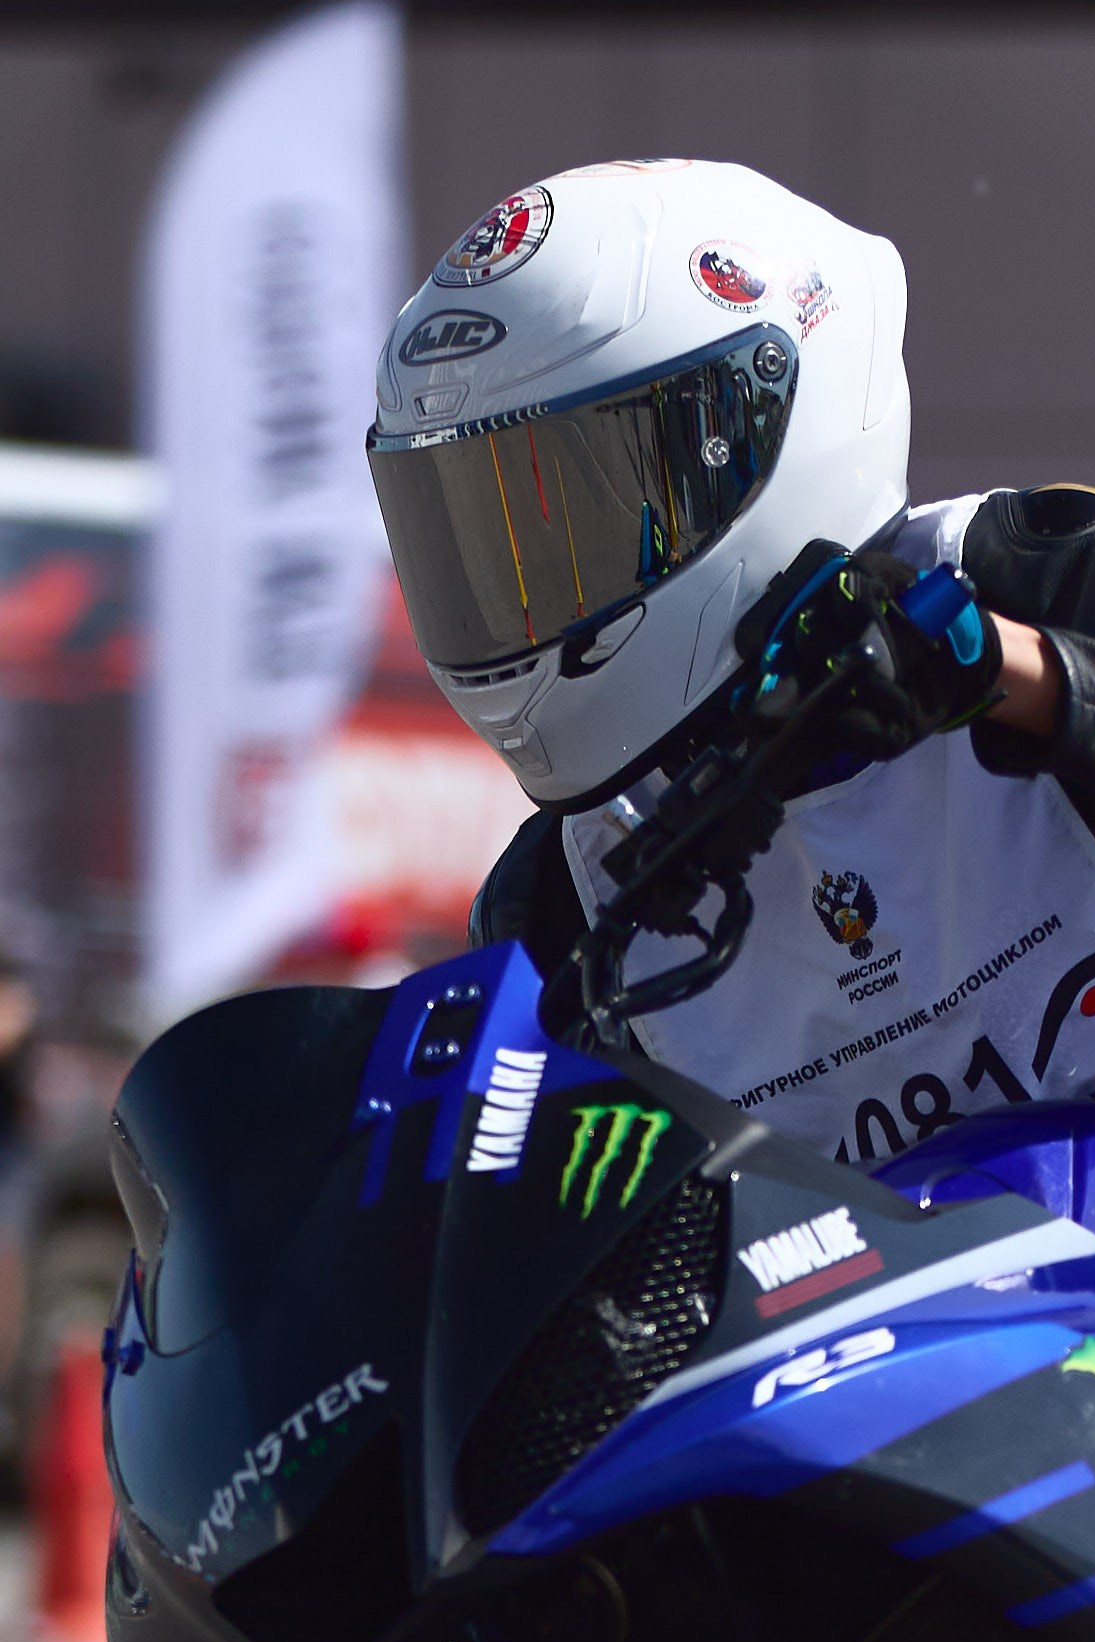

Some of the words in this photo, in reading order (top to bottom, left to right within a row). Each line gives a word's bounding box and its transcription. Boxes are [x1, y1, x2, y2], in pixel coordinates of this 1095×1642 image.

[707, 292, 760, 313] КОСТРОМА
[407, 321, 492, 359] HJC
[800, 305, 830, 343] ДЖАЗА
[829, 1008, 932, 1067] УПРАВЛЕНИЕ
[932, 914, 1063, 1018] МОТОЦИКЛОМ
[836, 949, 903, 991] МИНСПОРТ
[848, 970, 900, 1005] РОССИИ
[466, 1047, 548, 1172] YAMAHA
[736, 1206, 868, 1293] YAMALUBE
[752, 1326, 896, 1409] R3
